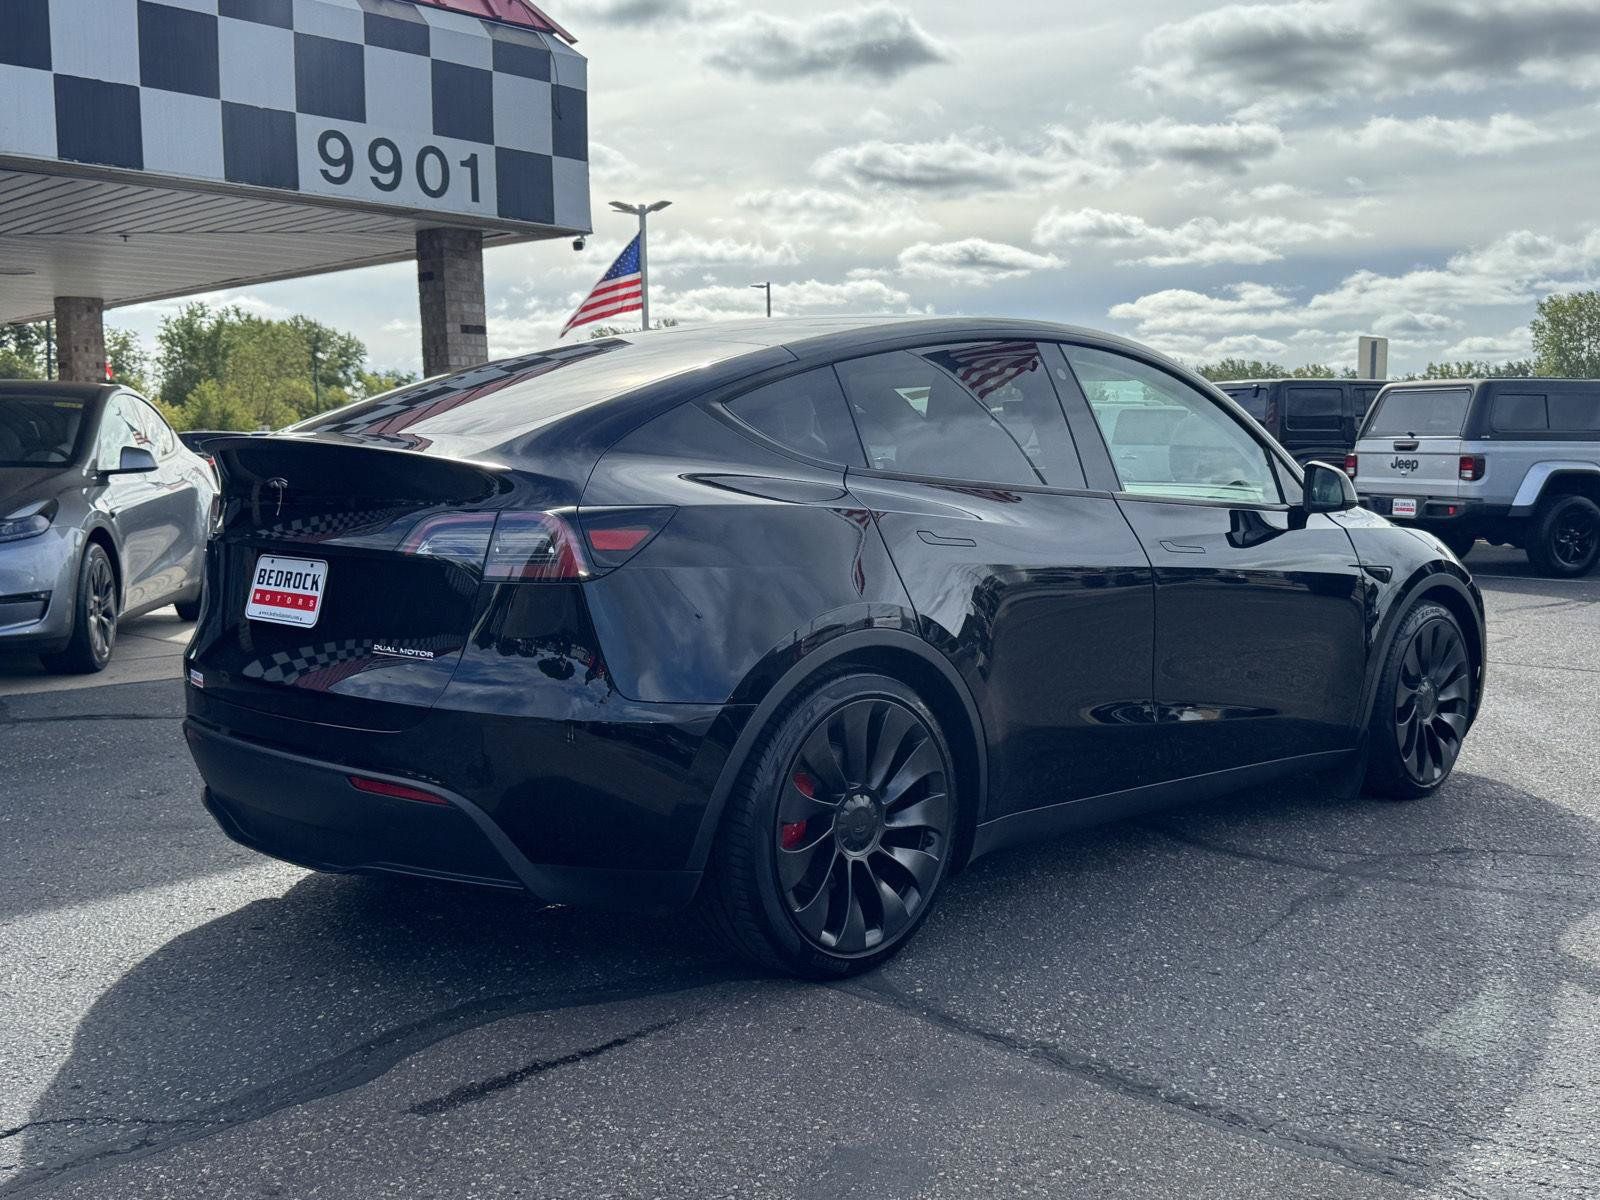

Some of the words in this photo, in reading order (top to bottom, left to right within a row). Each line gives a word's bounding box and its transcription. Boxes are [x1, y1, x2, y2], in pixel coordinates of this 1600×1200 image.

[317, 129, 480, 203] 9901
[1390, 455, 1419, 472] Jeep
[256, 568, 321, 592] BEDROCK
[255, 593, 315, 607] MOTORS
[373, 644, 398, 653] DUAL
[399, 647, 434, 658] MOTOR
